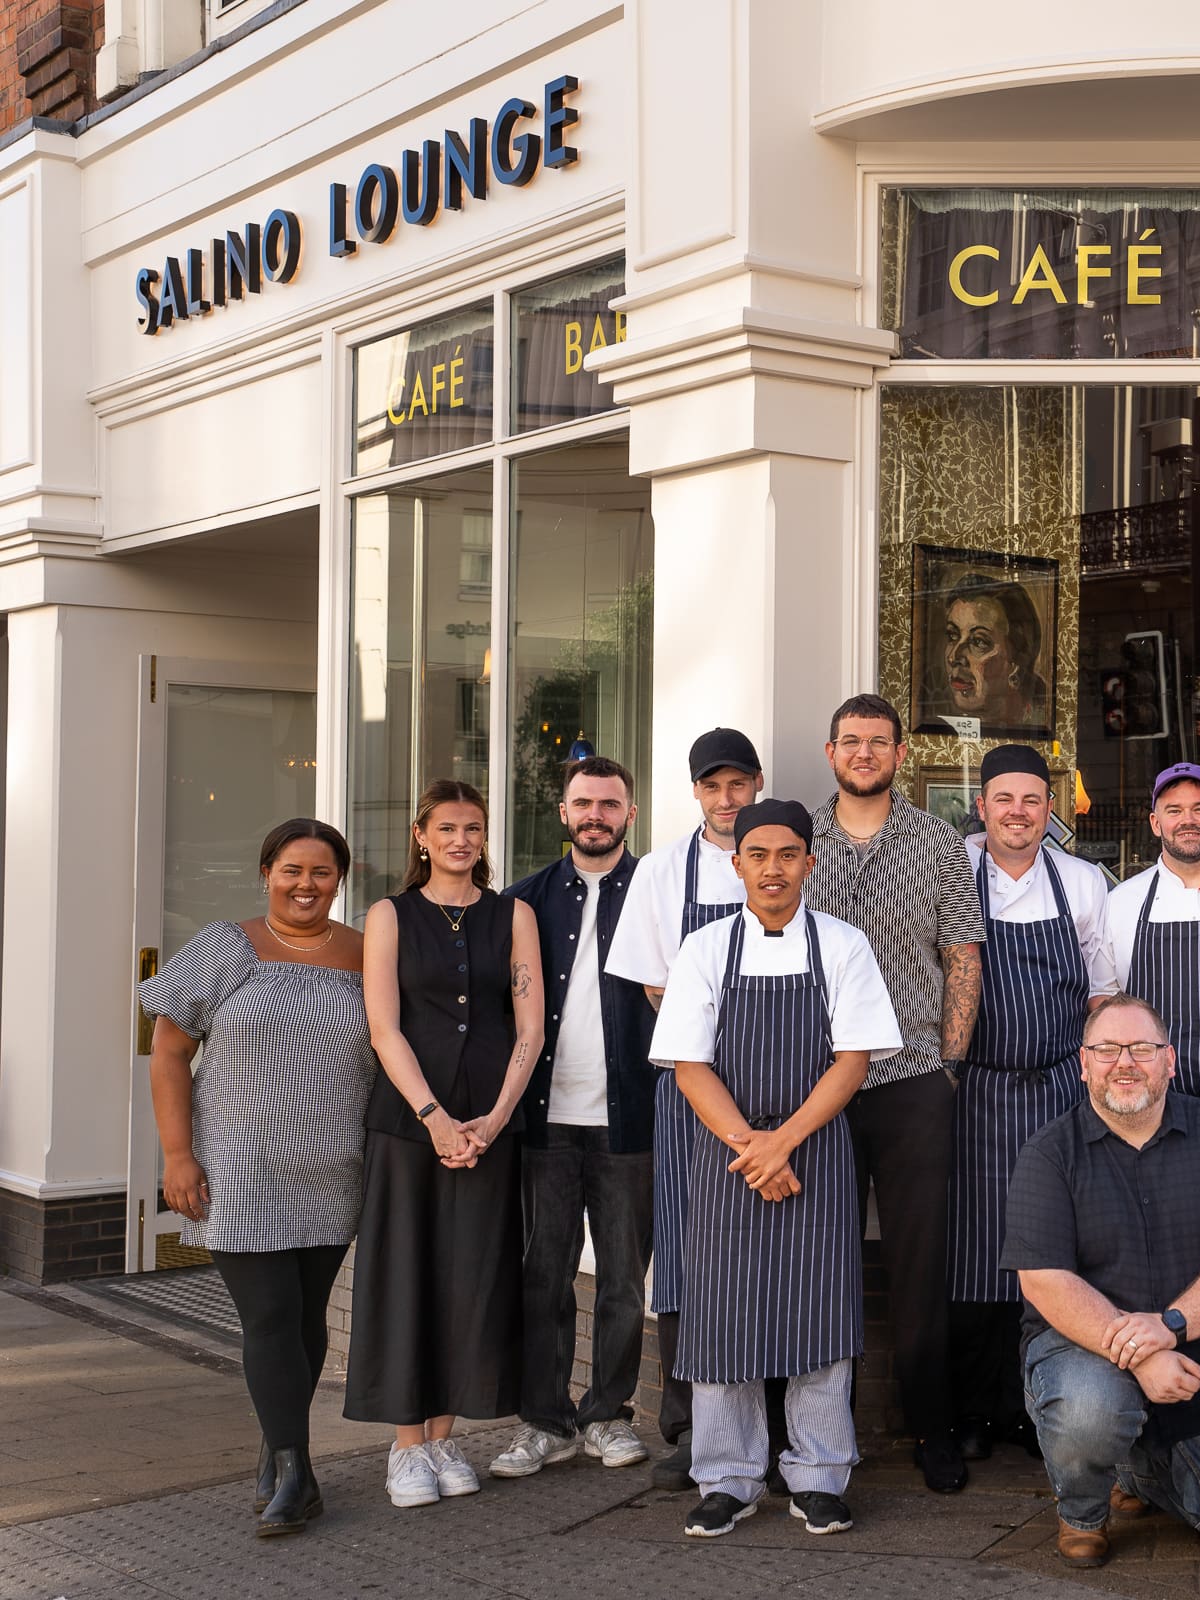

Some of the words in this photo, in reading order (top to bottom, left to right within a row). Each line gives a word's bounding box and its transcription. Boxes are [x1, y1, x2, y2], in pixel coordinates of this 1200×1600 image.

[136, 209, 300, 336] SALINO
[329, 75, 579, 258] LOUNGE
[949, 228, 1163, 307] CAFÉ
[387, 345, 464, 426] CAFÉ
